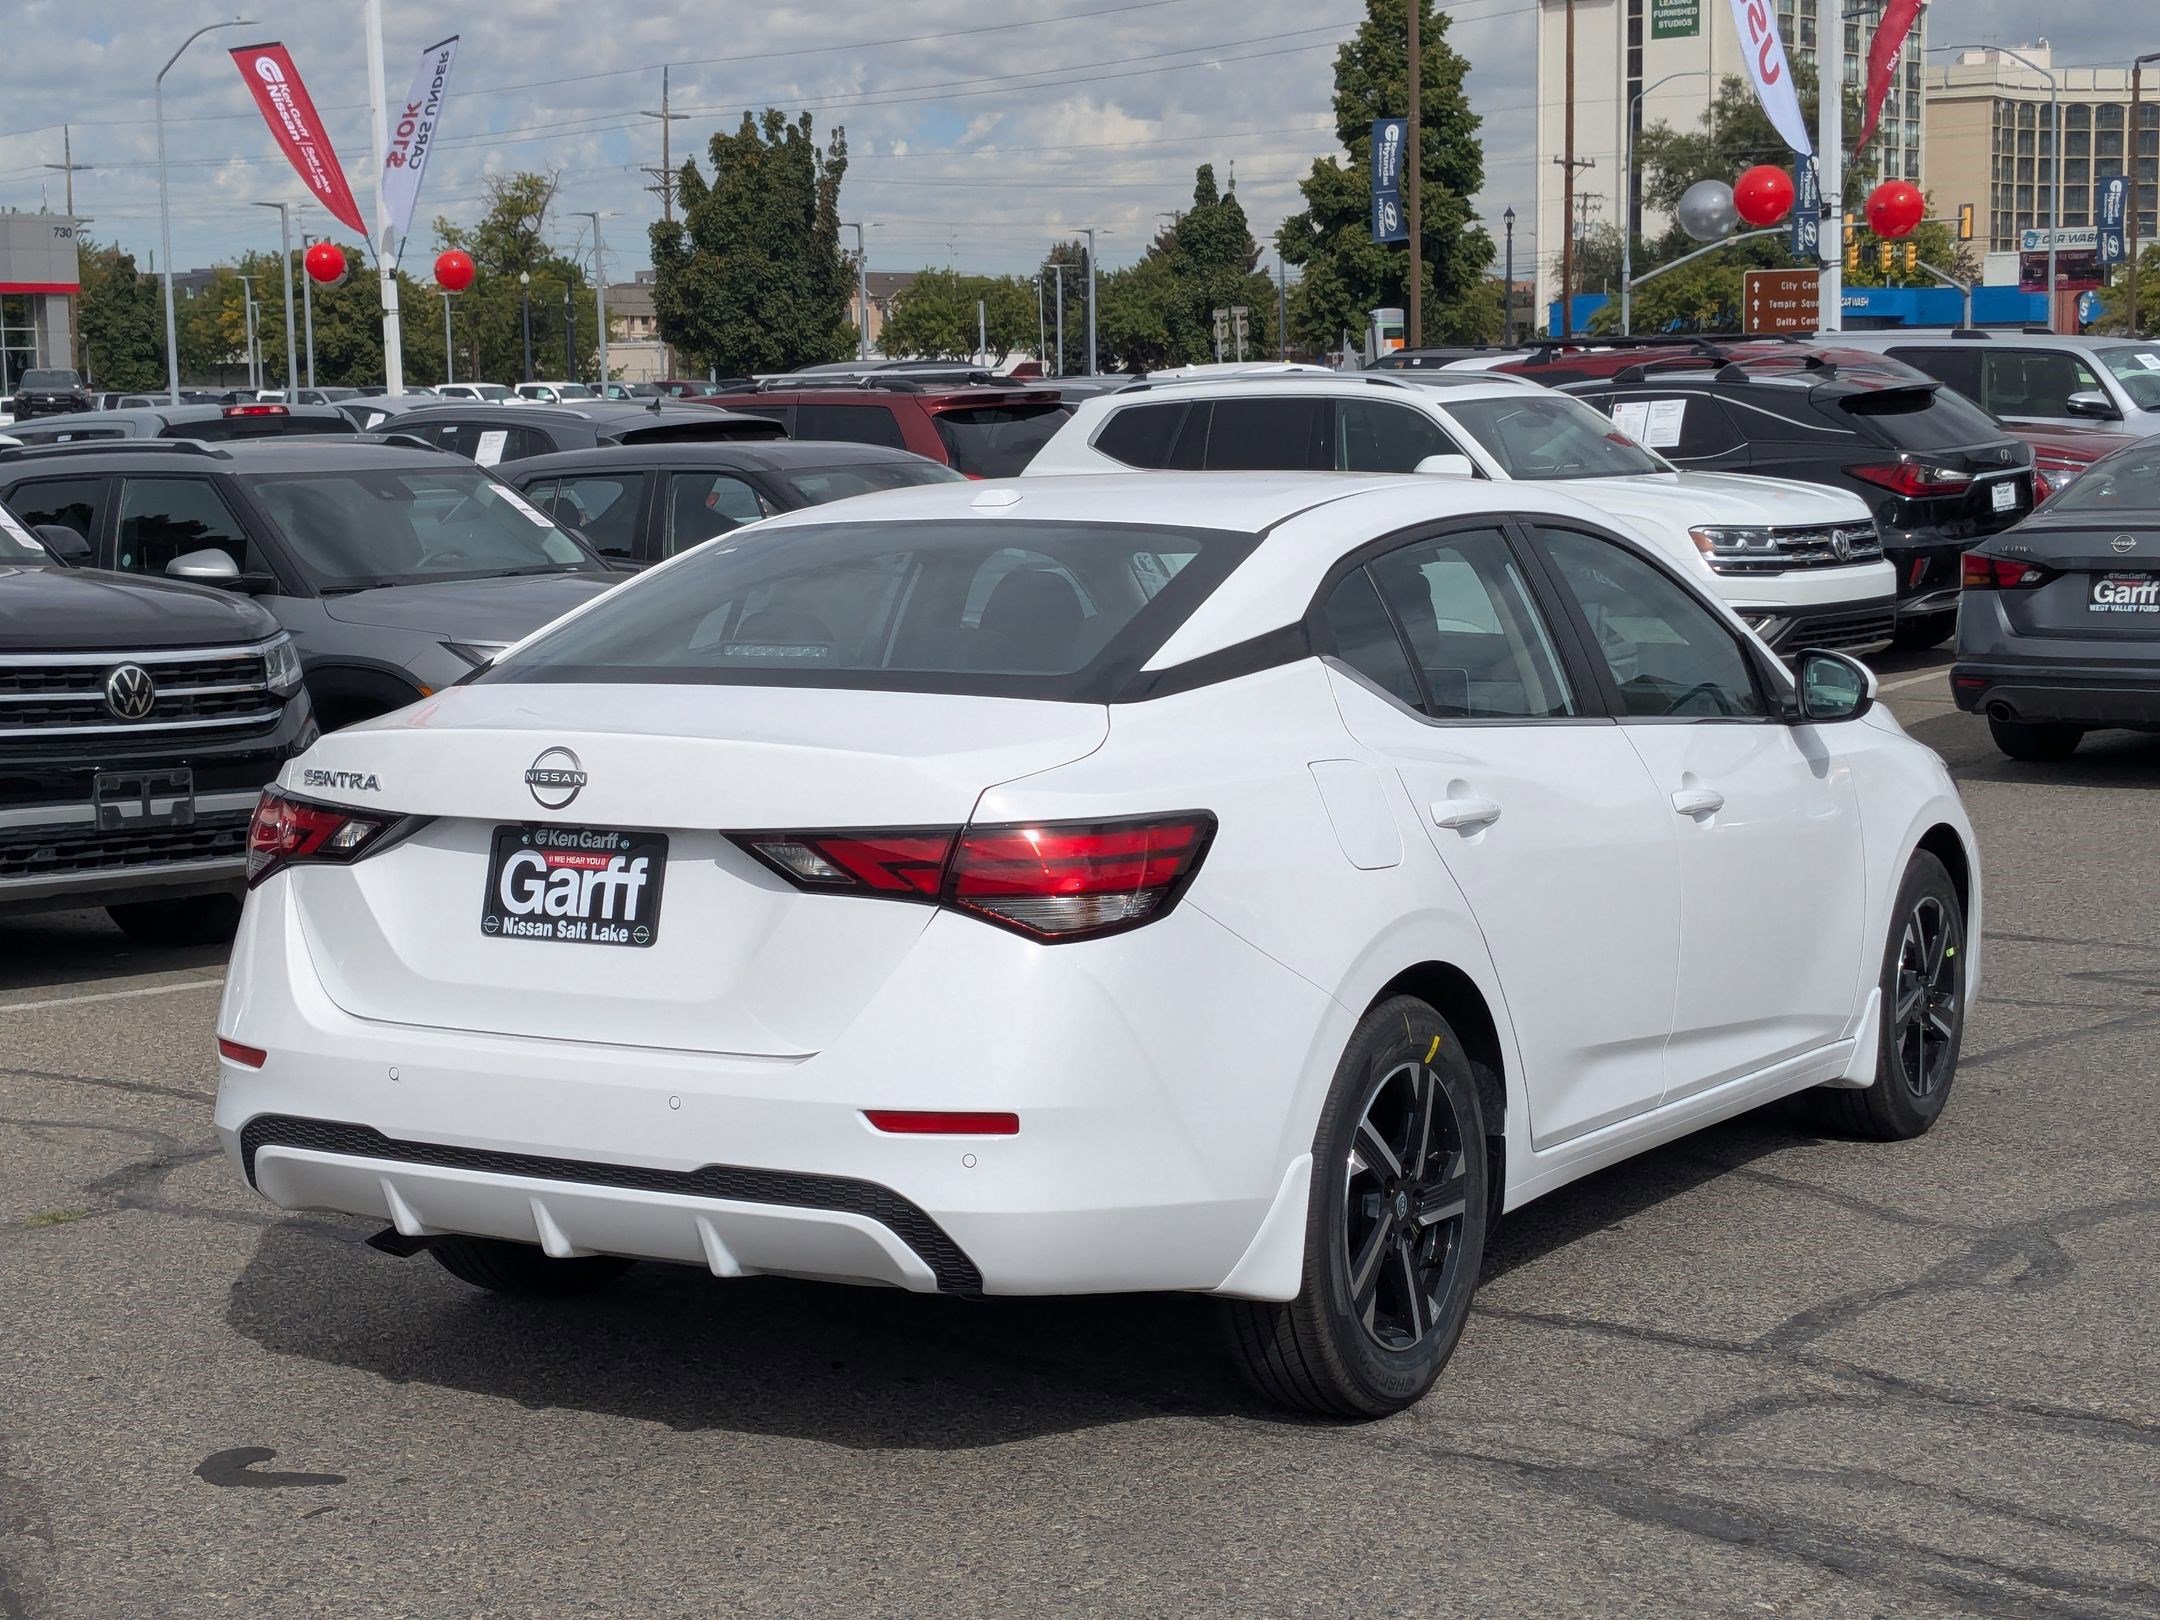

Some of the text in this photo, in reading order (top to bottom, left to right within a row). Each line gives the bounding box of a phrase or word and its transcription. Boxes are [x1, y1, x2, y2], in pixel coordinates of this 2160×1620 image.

[1653, 7, 1698, 18] FURNISHED
[1658, 18, 1693, 29] STUDIOS
[266, 84, 300, 141] Nissan
[278, 83, 294, 108] Ken
[290, 108, 310, 138] Garff
[1382, 142, 1391, 187] Hyundai
[53, 226, 72, 239] 730
[1781, 280, 1819, 291] City Cent
[1769, 298, 1819, 310] Temple Squa
[1776, 316, 1819, 327] Delta Cent
[2094, 580, 2160, 604] Garff
[2089, 604, 2160, 612] WEST VALLEY FORD
[304, 769, 382, 792] SENTRA
[526, 771, 586, 784] NISSAN
[548, 829, 619, 849] Ken Garff
[554, 855, 601, 866] WE HEAR YOU
[500, 849, 649, 921] Garff
[503, 916, 628, 943] Nissan Salt Lake
